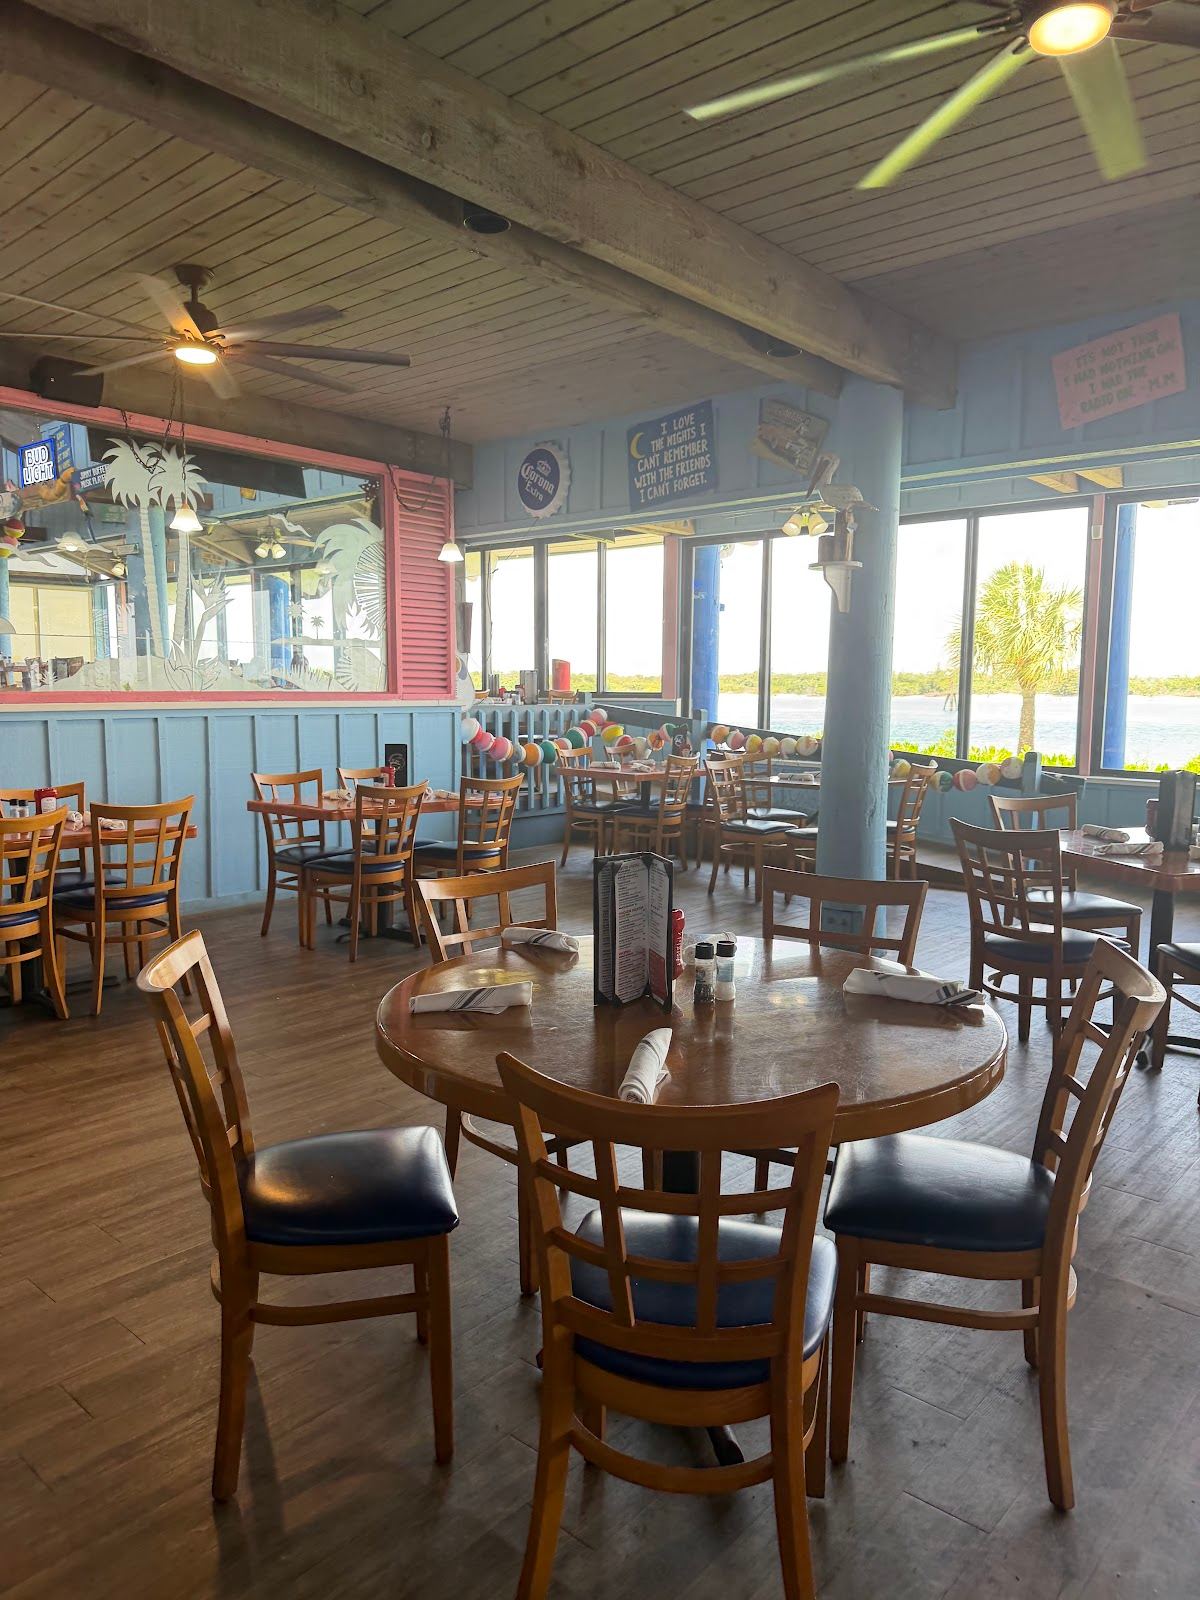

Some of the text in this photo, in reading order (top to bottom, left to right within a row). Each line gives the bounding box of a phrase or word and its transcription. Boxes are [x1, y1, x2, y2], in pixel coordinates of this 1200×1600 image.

[1102, 341, 1125, 357] NOT
[660, 413, 696, 435] I LOVE
[651, 423, 706, 453] THE NIGHTS I
[25, 445, 49, 467] BUD
[663, 439, 708, 465] REMEMBER
[22, 461, 55, 485] LIGHT
[521, 463, 555, 495] Corona
[634, 454, 711, 489] WITH THE FRIENDS
[525, 479, 543, 502] Extra
[639, 489, 646, 503] I
